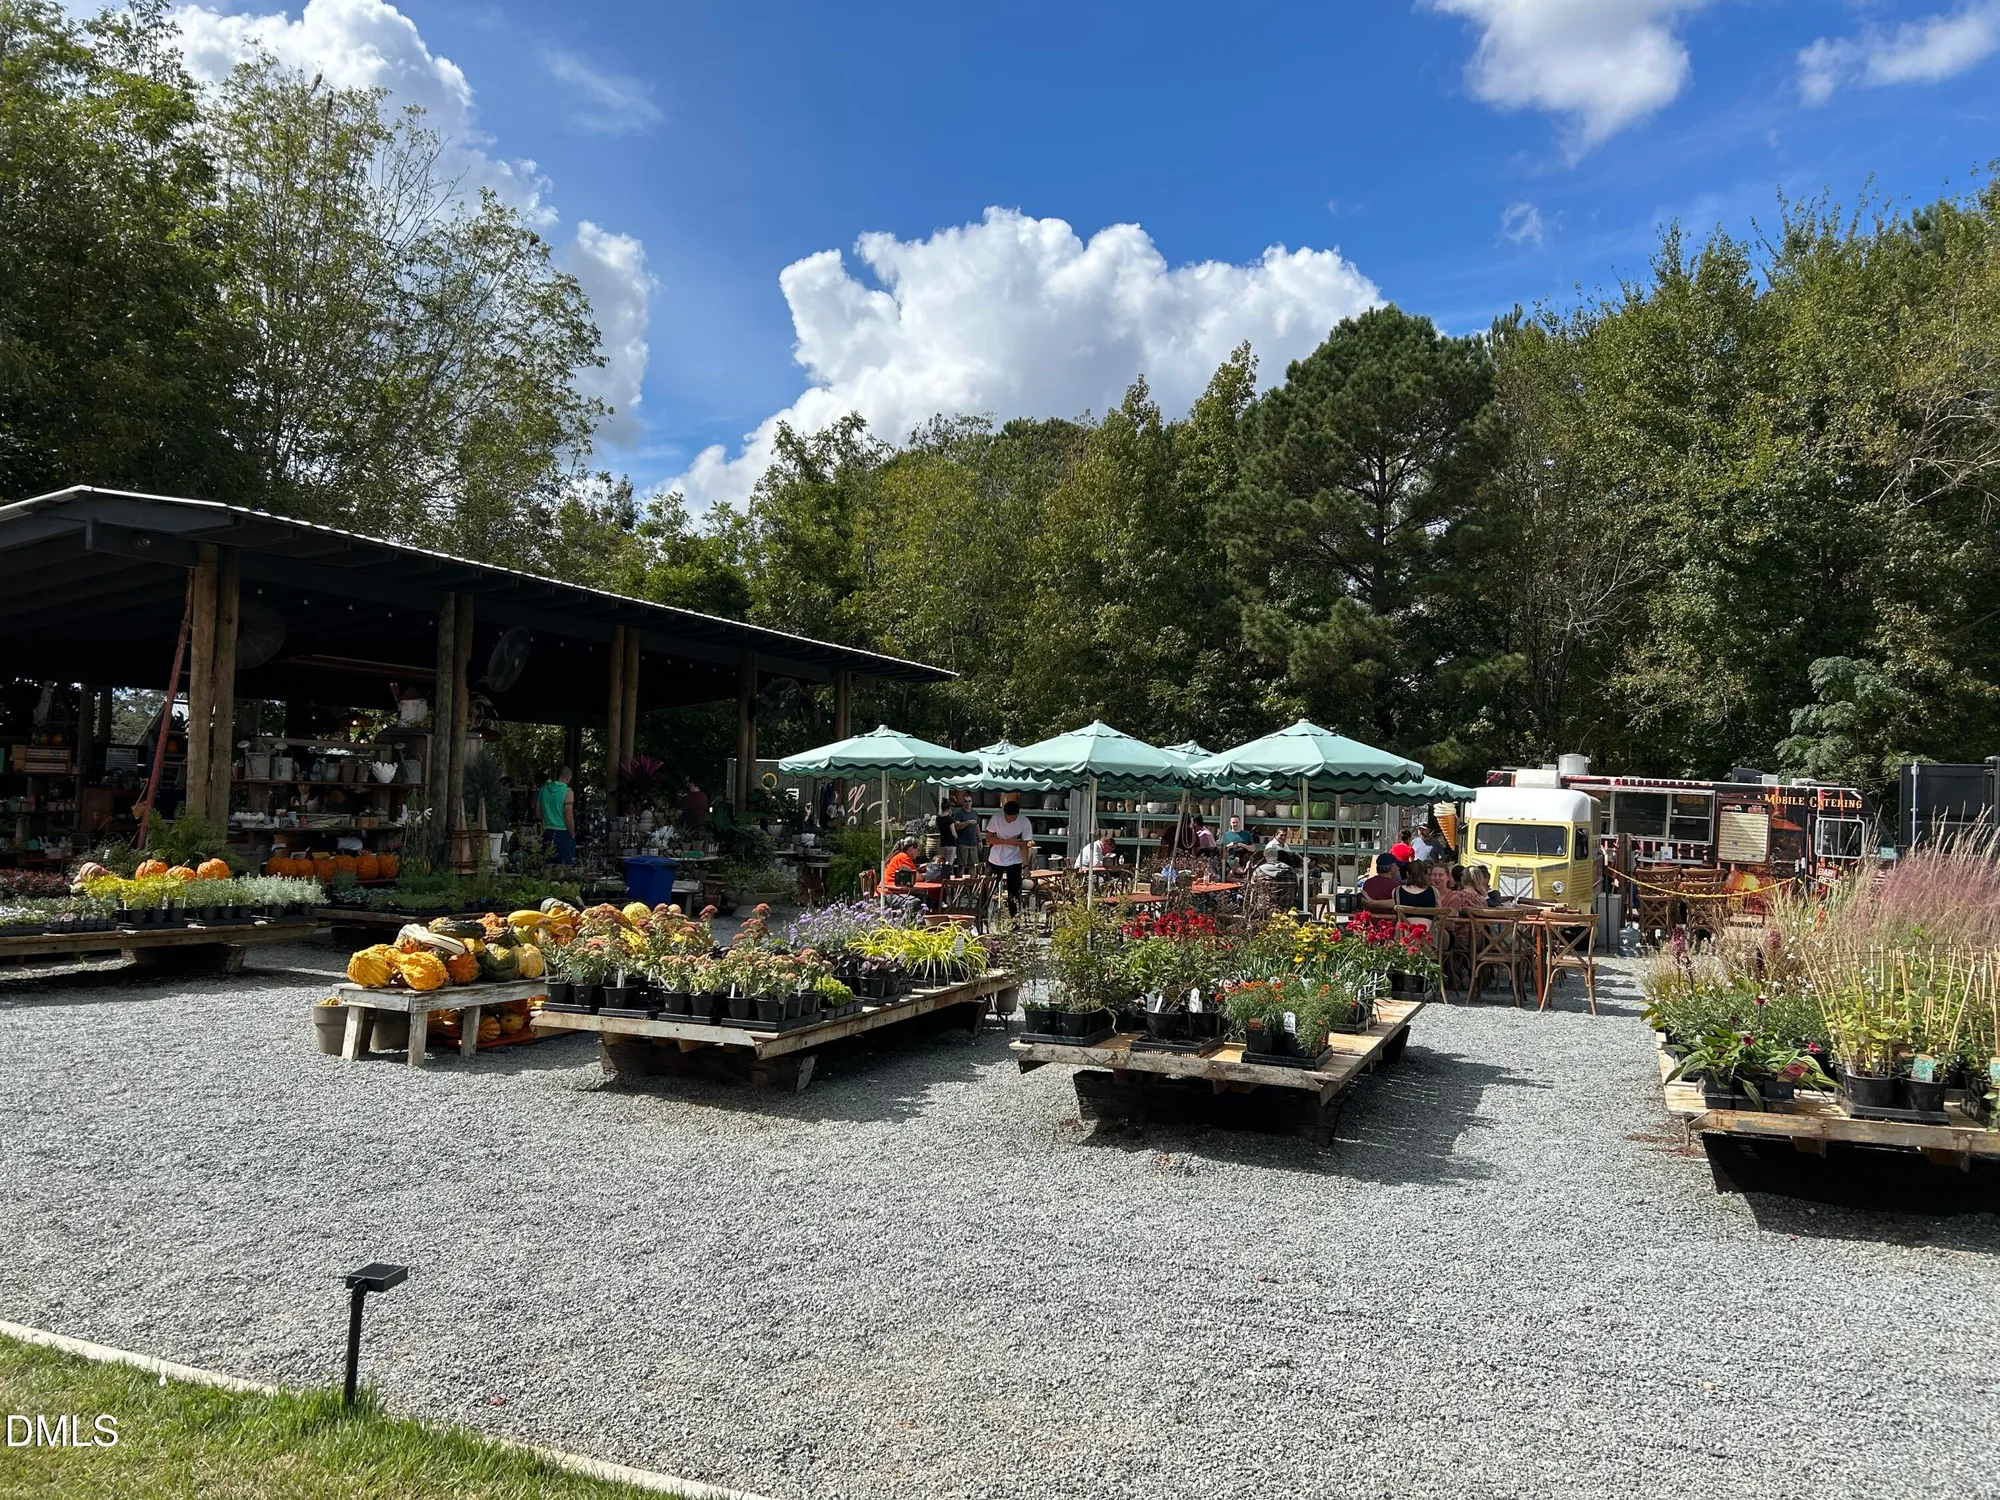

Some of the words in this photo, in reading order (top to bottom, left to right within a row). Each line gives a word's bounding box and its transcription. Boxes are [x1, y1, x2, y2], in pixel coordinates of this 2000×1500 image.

[1764, 794, 1805, 806] MOBILE
[1810, 796, 1863, 809] CATERING
[1818, 867, 1834, 877] BAR
